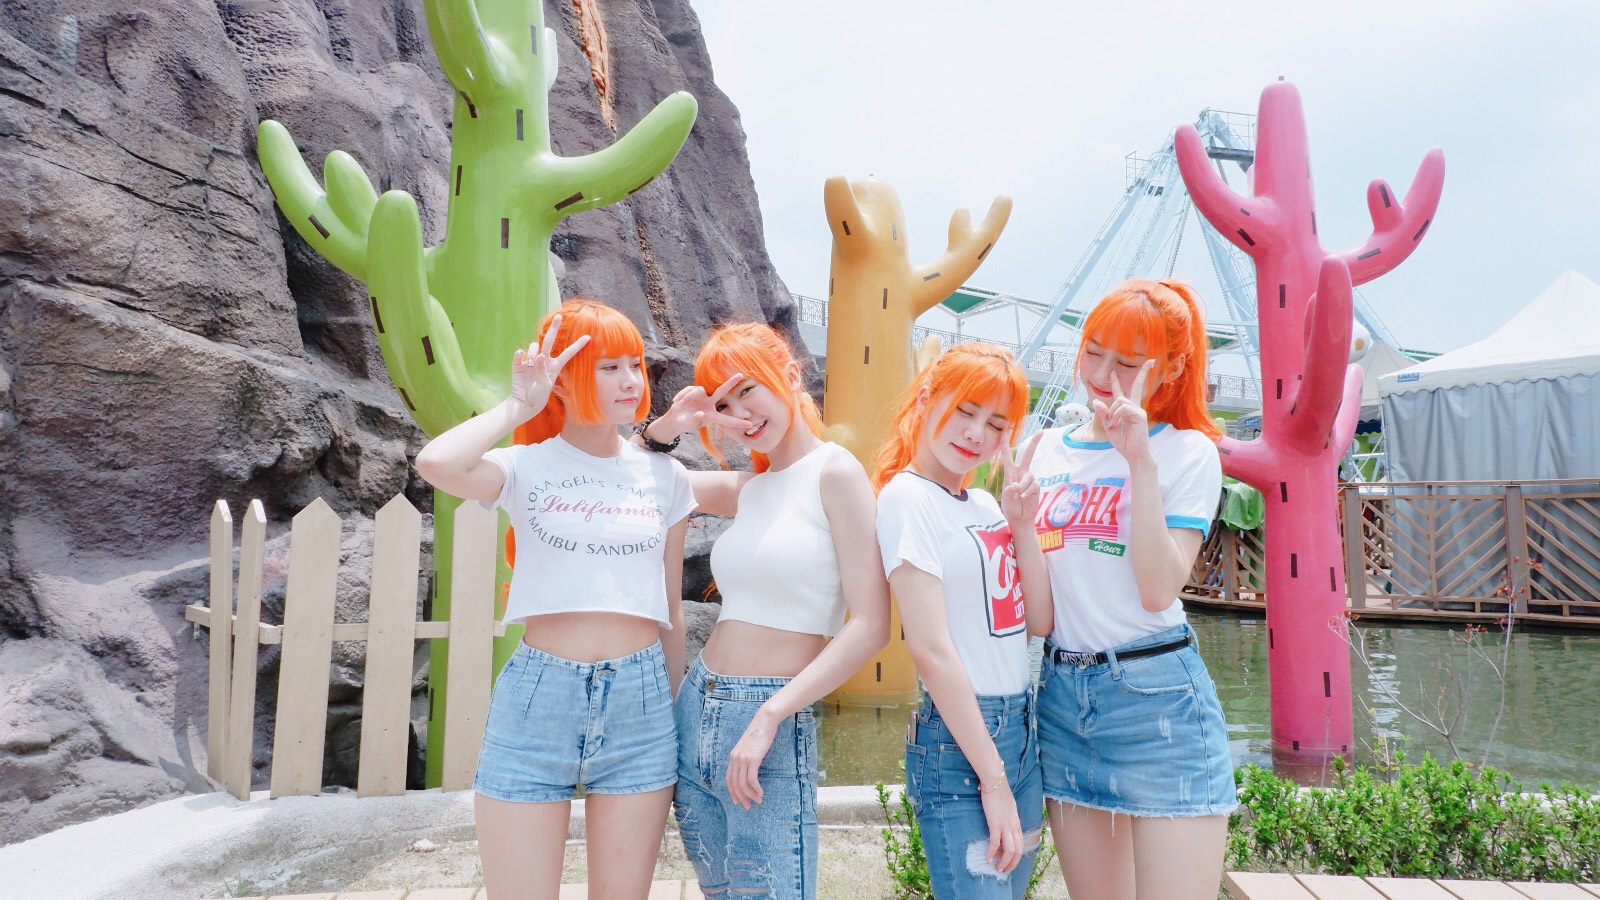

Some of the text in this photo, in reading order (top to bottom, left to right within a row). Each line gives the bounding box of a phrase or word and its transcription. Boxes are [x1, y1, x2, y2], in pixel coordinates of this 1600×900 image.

[1035, 483, 1122, 531] LOHA
[528, 516, 663, 557] MALIBU SANDIEGO
[1093, 540, 1122, 555] Hour
